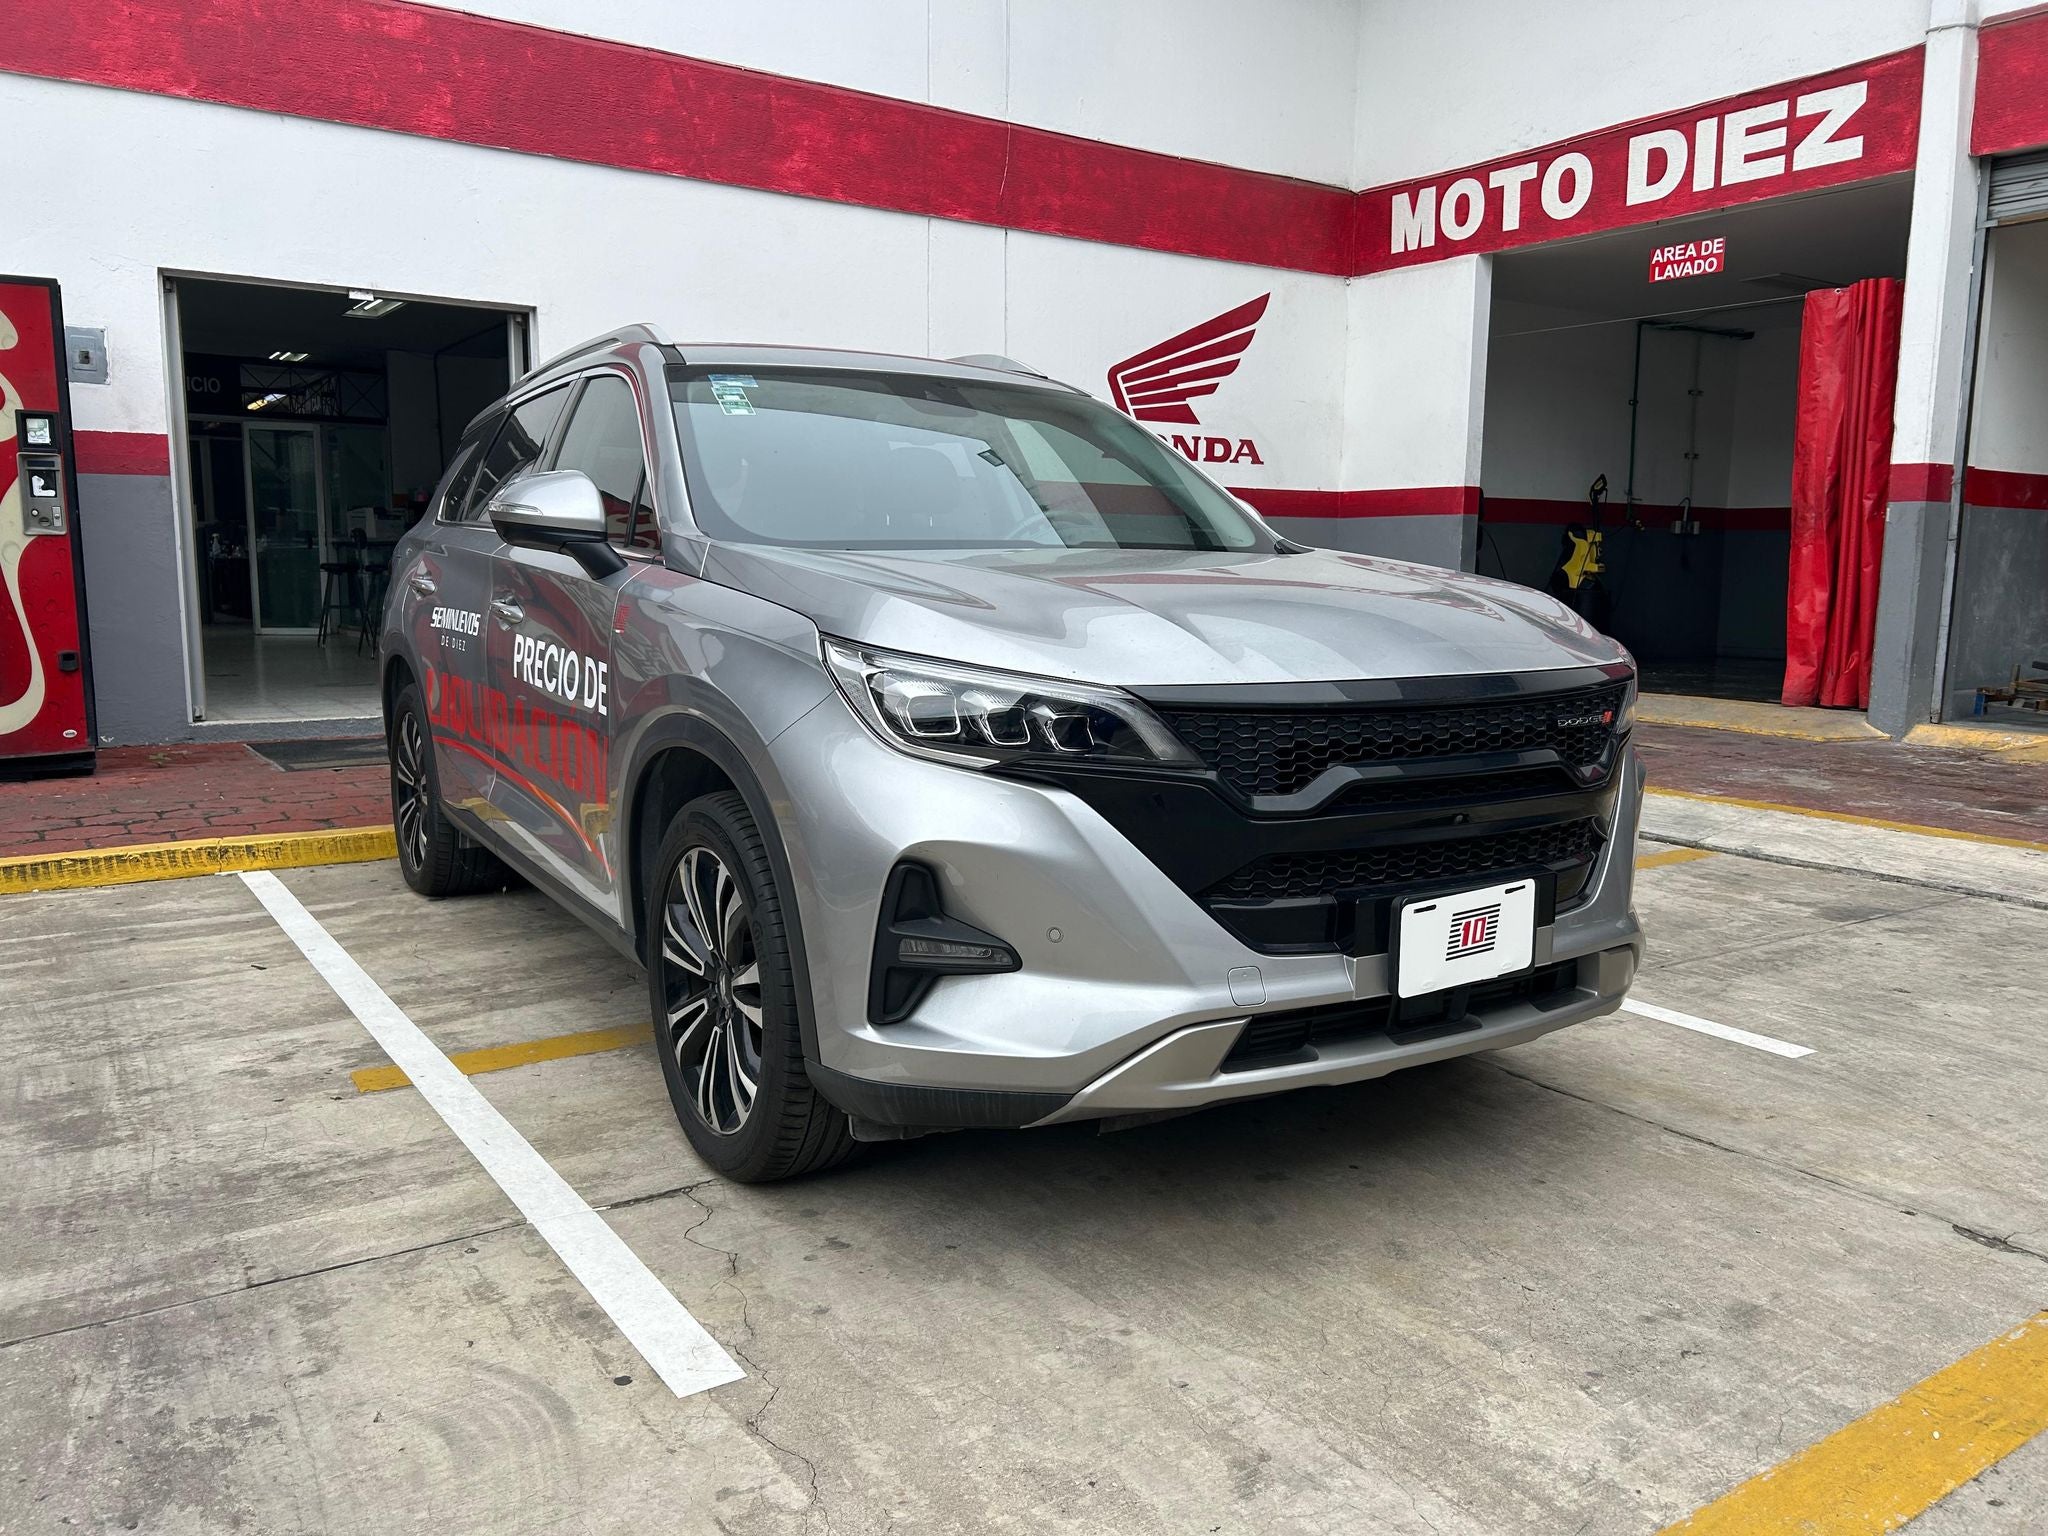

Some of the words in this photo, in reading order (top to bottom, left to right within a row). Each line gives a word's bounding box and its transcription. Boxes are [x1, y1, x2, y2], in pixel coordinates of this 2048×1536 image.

[1391, 152, 1593, 254] MOTO
[1626, 80, 1868, 206] DIEZ
[1652, 243, 1697, 264] AREA
[1701, 238, 1723, 256] DE
[1655, 257, 1717, 280] LAVADO
[430, 606, 481, 636] SEMINUEVOS
[441, 635, 449, 647] DE
[452, 638, 466, 651] DIEZ
[513, 633, 580, 700] PRECIO
[584, 656, 608, 716] DE
[425, 668, 608, 809] LIQUIDACIÓN
[1461, 916, 1487, 947] 10
